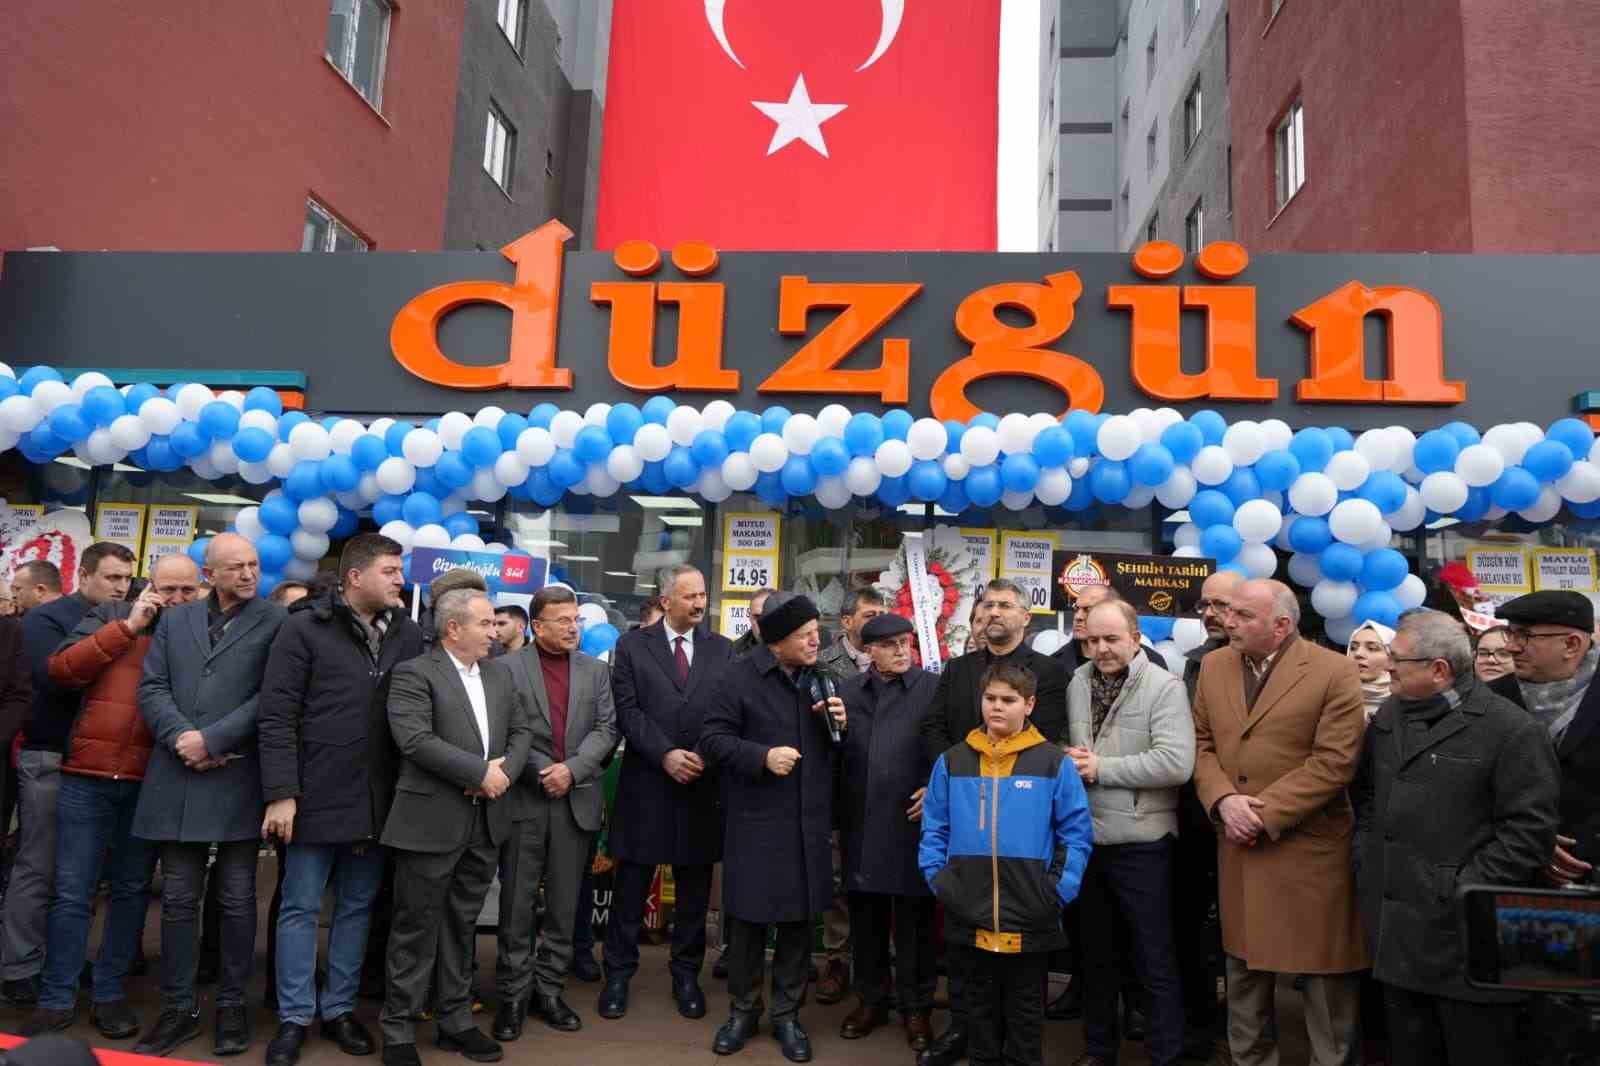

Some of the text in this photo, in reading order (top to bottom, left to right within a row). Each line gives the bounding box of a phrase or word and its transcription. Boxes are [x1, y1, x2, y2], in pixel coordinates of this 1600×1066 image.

[390, 218, 1467, 421] düzgün
[737, 520, 765, 528] MUTLU
[1543, 555, 1588, 563] MAYLO
[1117, 561, 1208, 577] ŞEHRİN TARİHİ
[729, 568, 768, 586] 14.95
[1134, 577, 1190, 589] MARKASI
[731, 607, 745, 618] TAT
